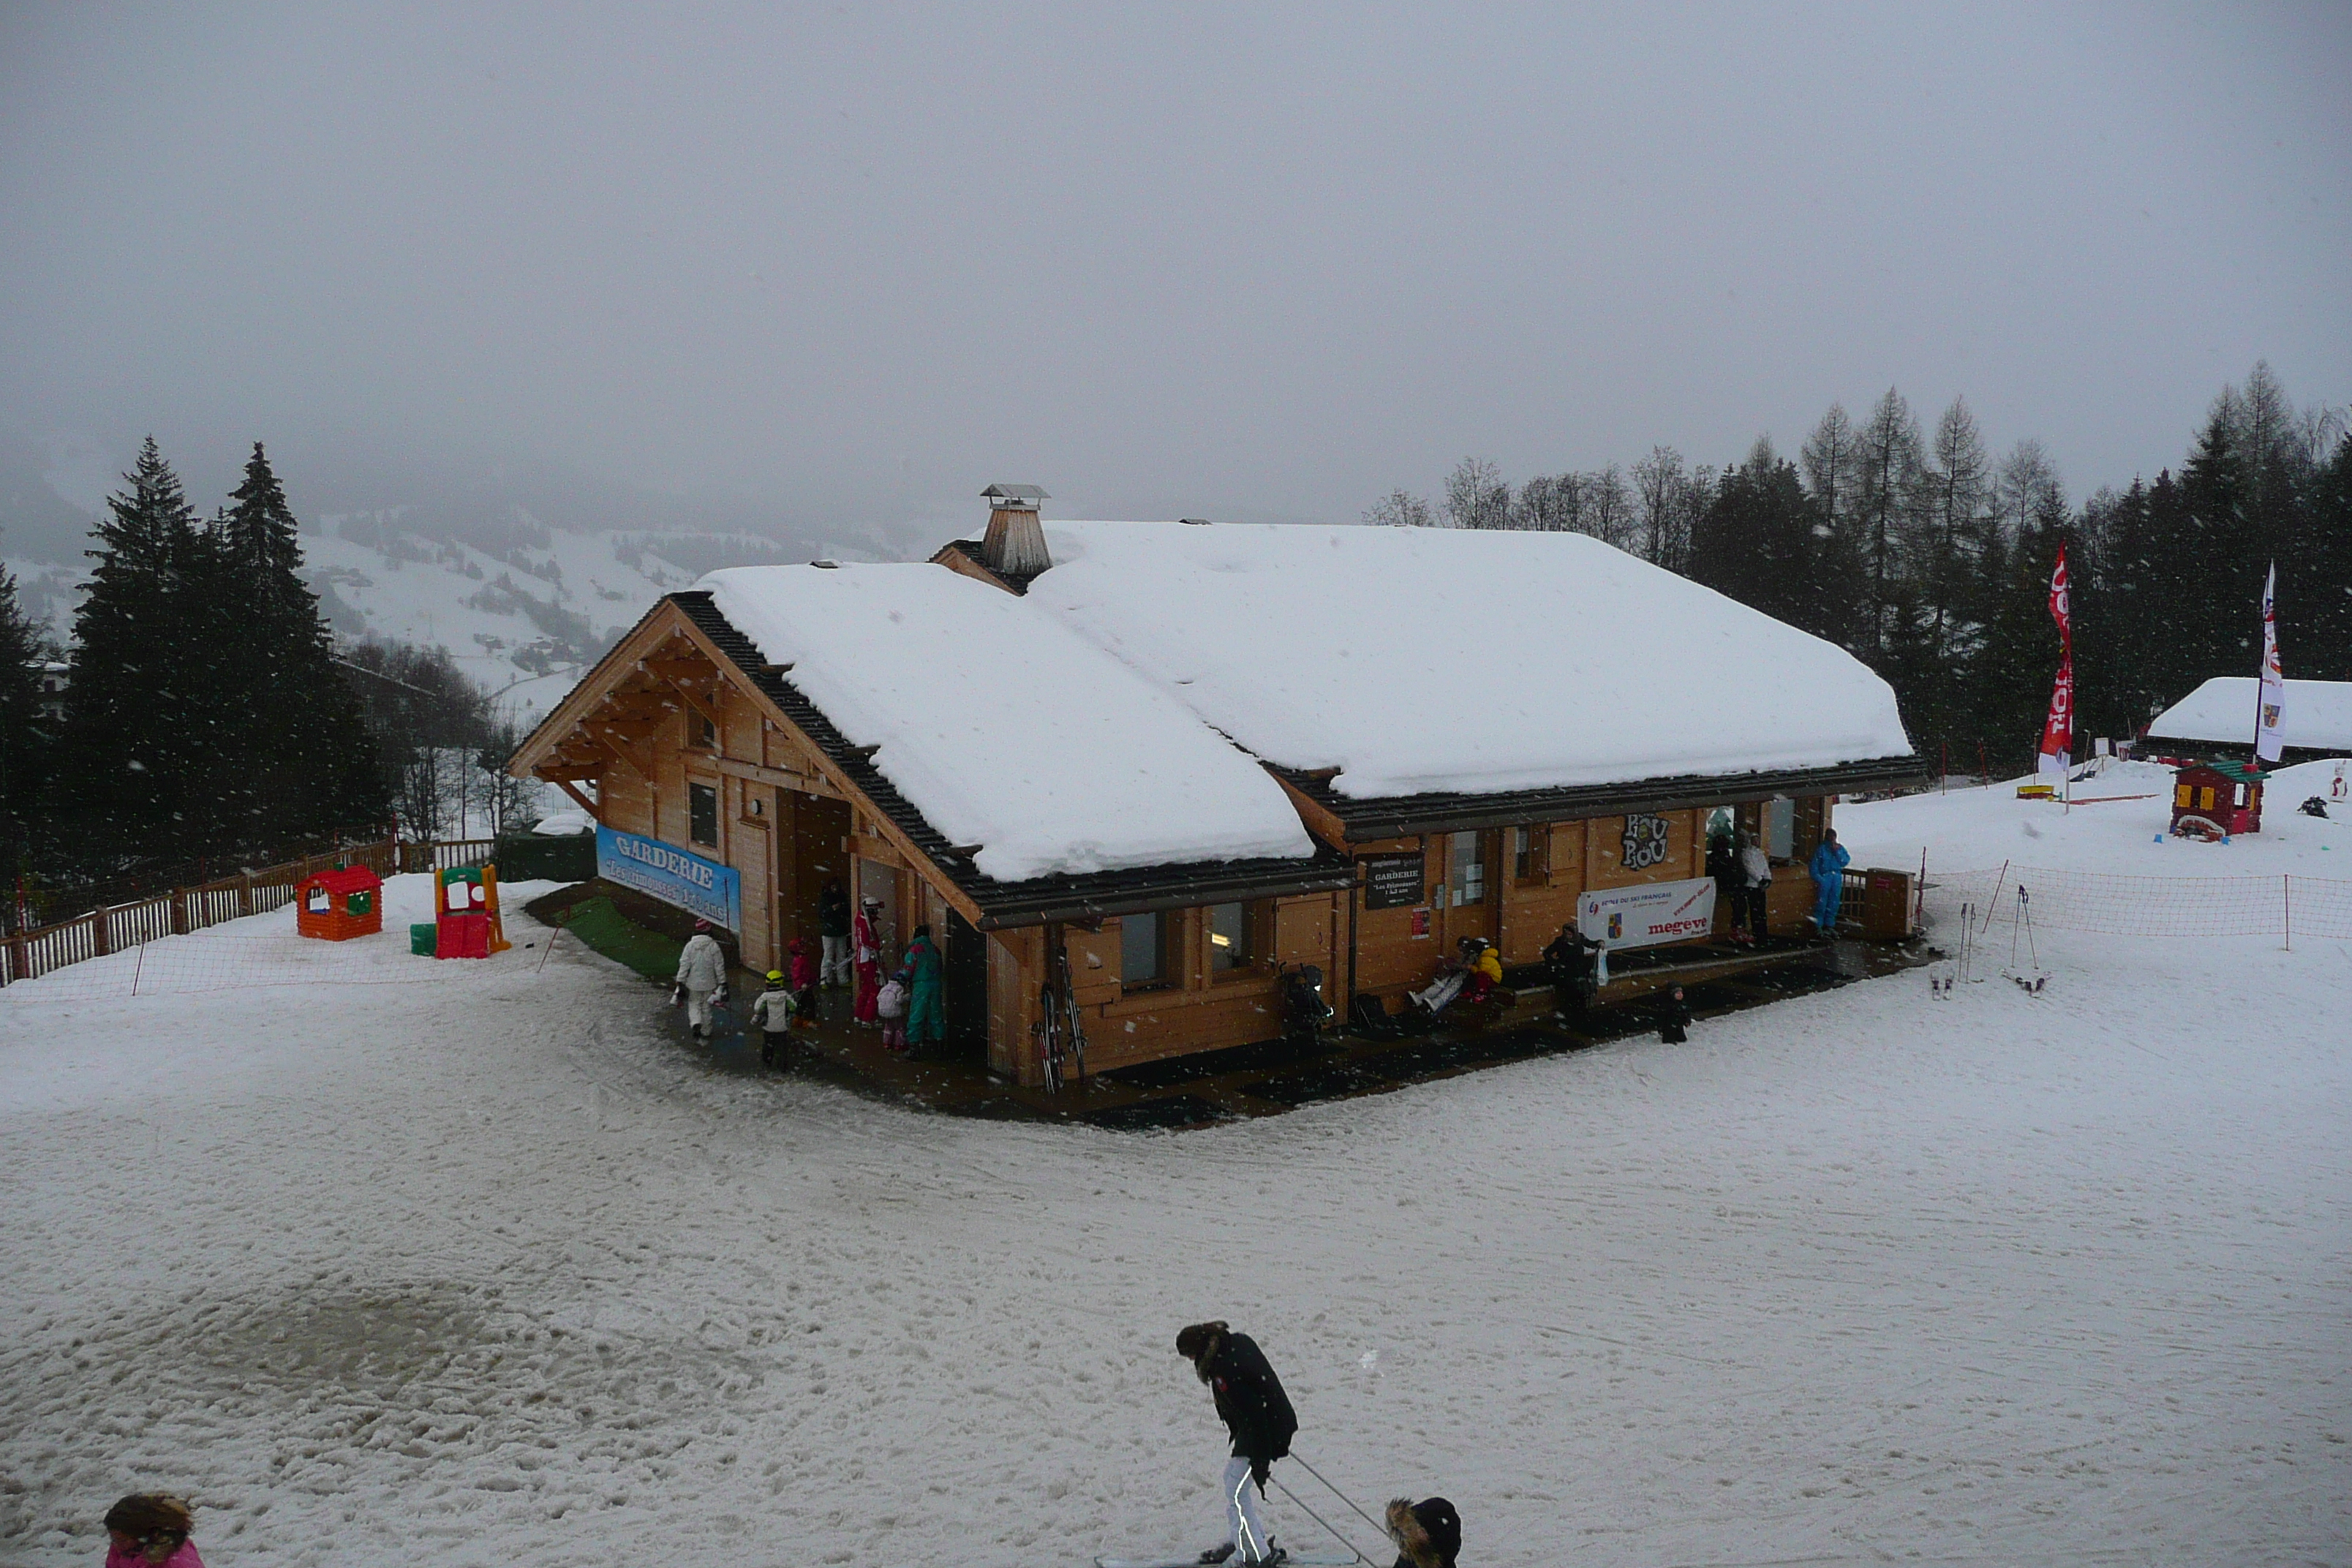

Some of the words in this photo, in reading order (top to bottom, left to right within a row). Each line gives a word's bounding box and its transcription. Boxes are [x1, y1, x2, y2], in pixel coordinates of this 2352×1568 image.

[616, 836, 713, 890] GARDERIE
[1375, 870, 1418, 881] GARDERIE
[1601, 898, 1618, 906] ECOLE
[1641, 892, 1672, 900] FRANÇAIS
[704, 901, 724, 921] ans
